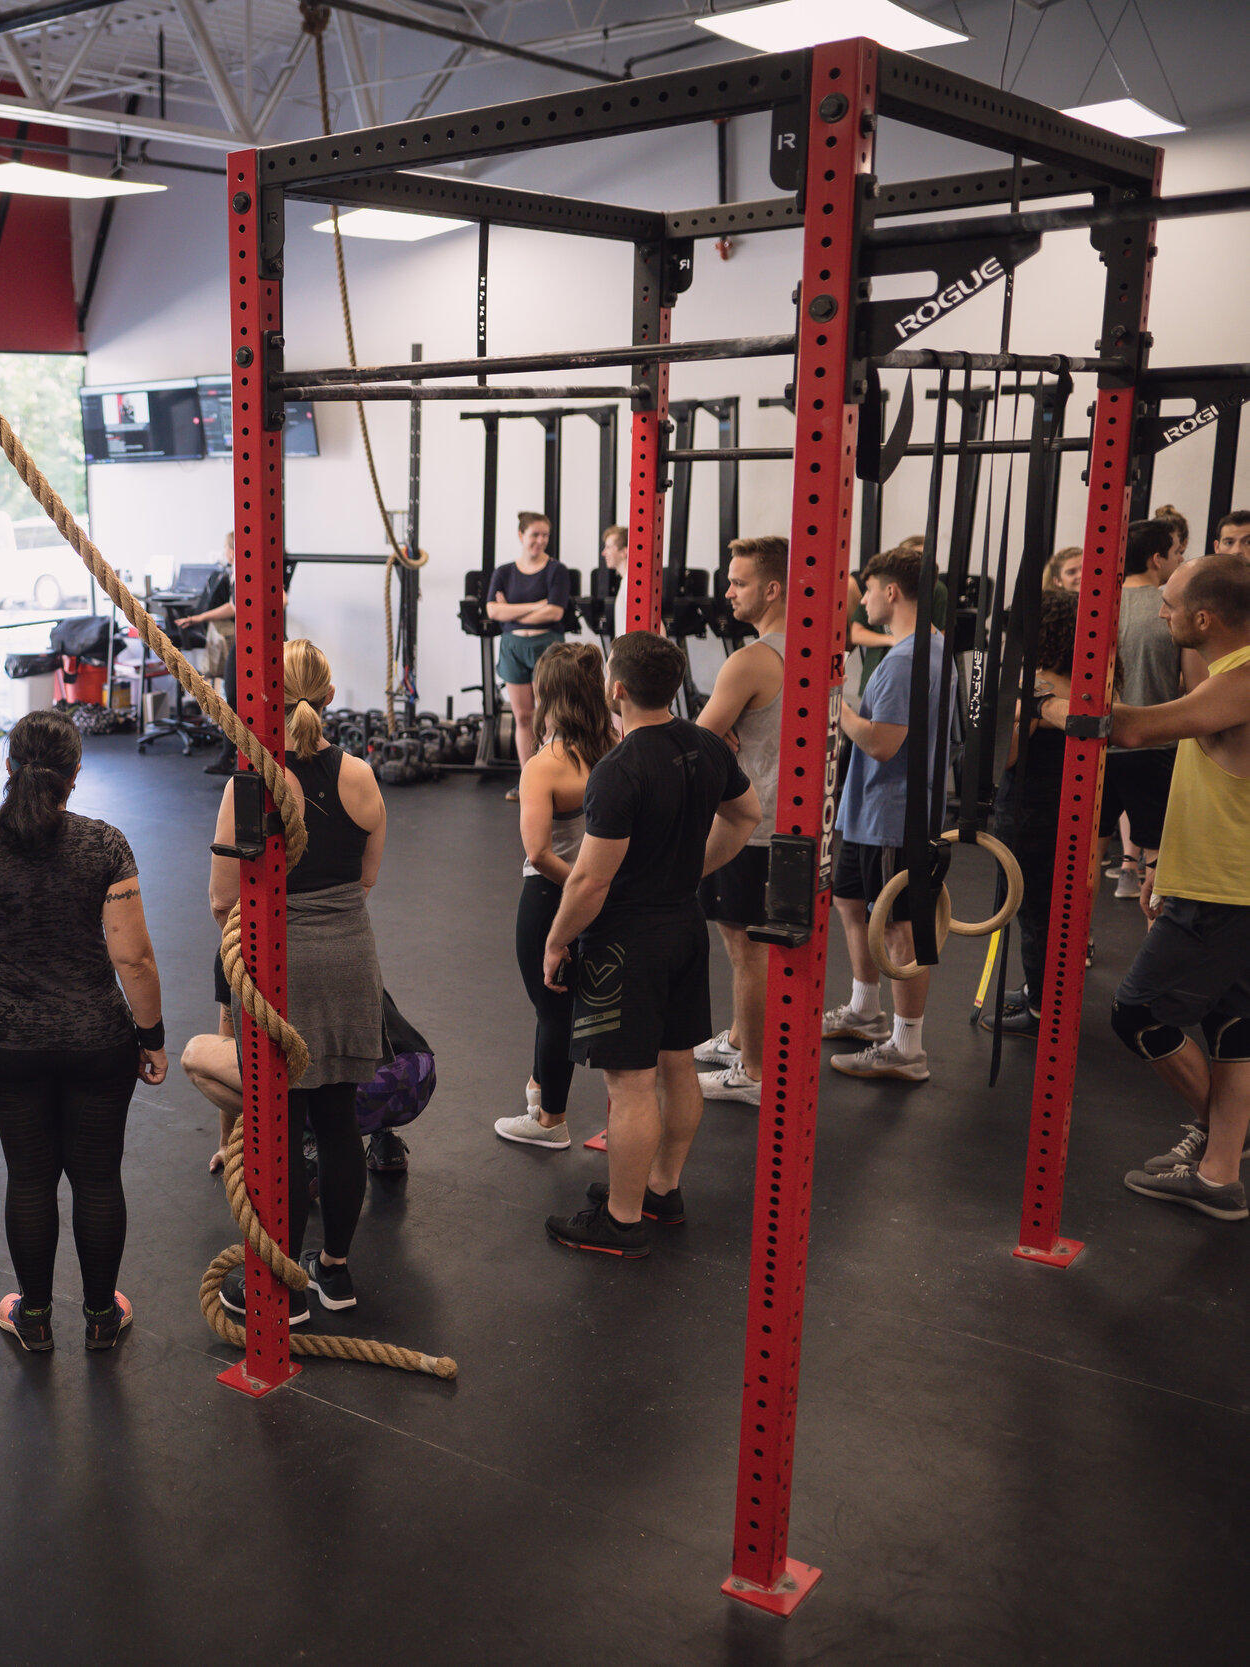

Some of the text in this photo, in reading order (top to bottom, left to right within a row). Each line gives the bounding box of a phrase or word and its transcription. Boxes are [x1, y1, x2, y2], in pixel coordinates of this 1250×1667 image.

[777, 132, 796, 151] R
[894, 256, 1005, 339] ROGUE
[1163, 404, 1220, 444] ROG
[830, 654, 843, 681] R
[819, 693, 842, 867] ROGUE
